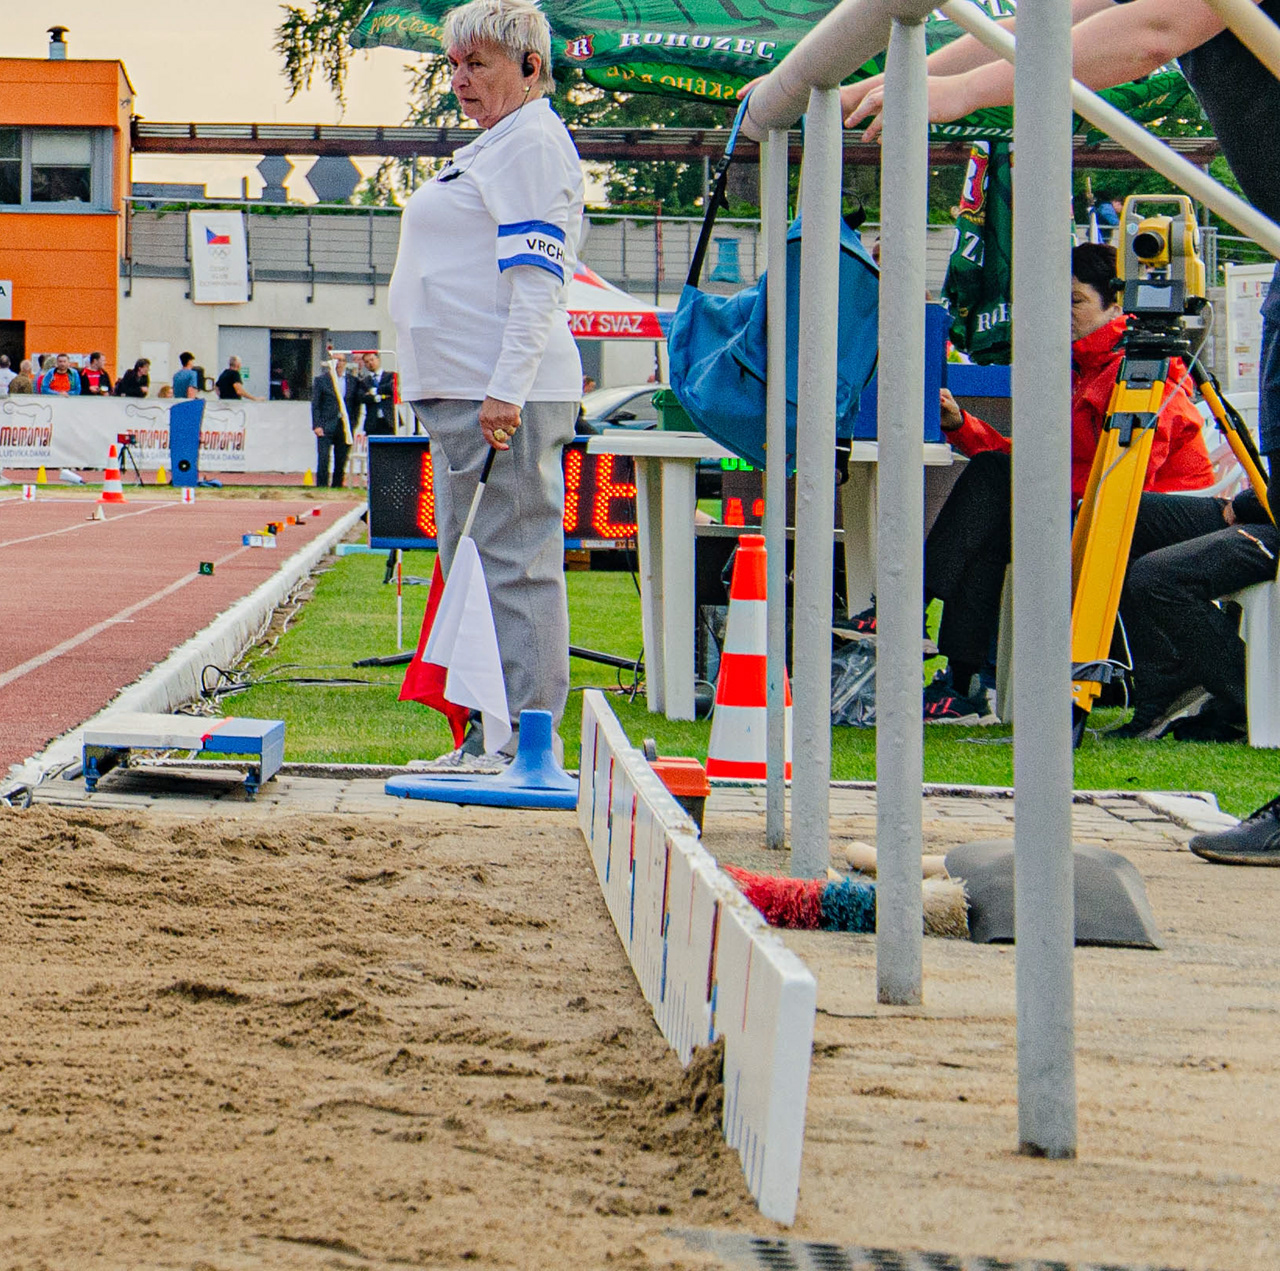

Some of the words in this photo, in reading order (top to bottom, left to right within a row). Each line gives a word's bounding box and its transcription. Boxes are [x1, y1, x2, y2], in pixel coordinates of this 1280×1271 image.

[619, 32, 777, 60] ROHOZEC
[569, 311, 595, 332] KÝ
[599, 314, 643, 333] SVAZ
[203, 563, 210, 573] 6
